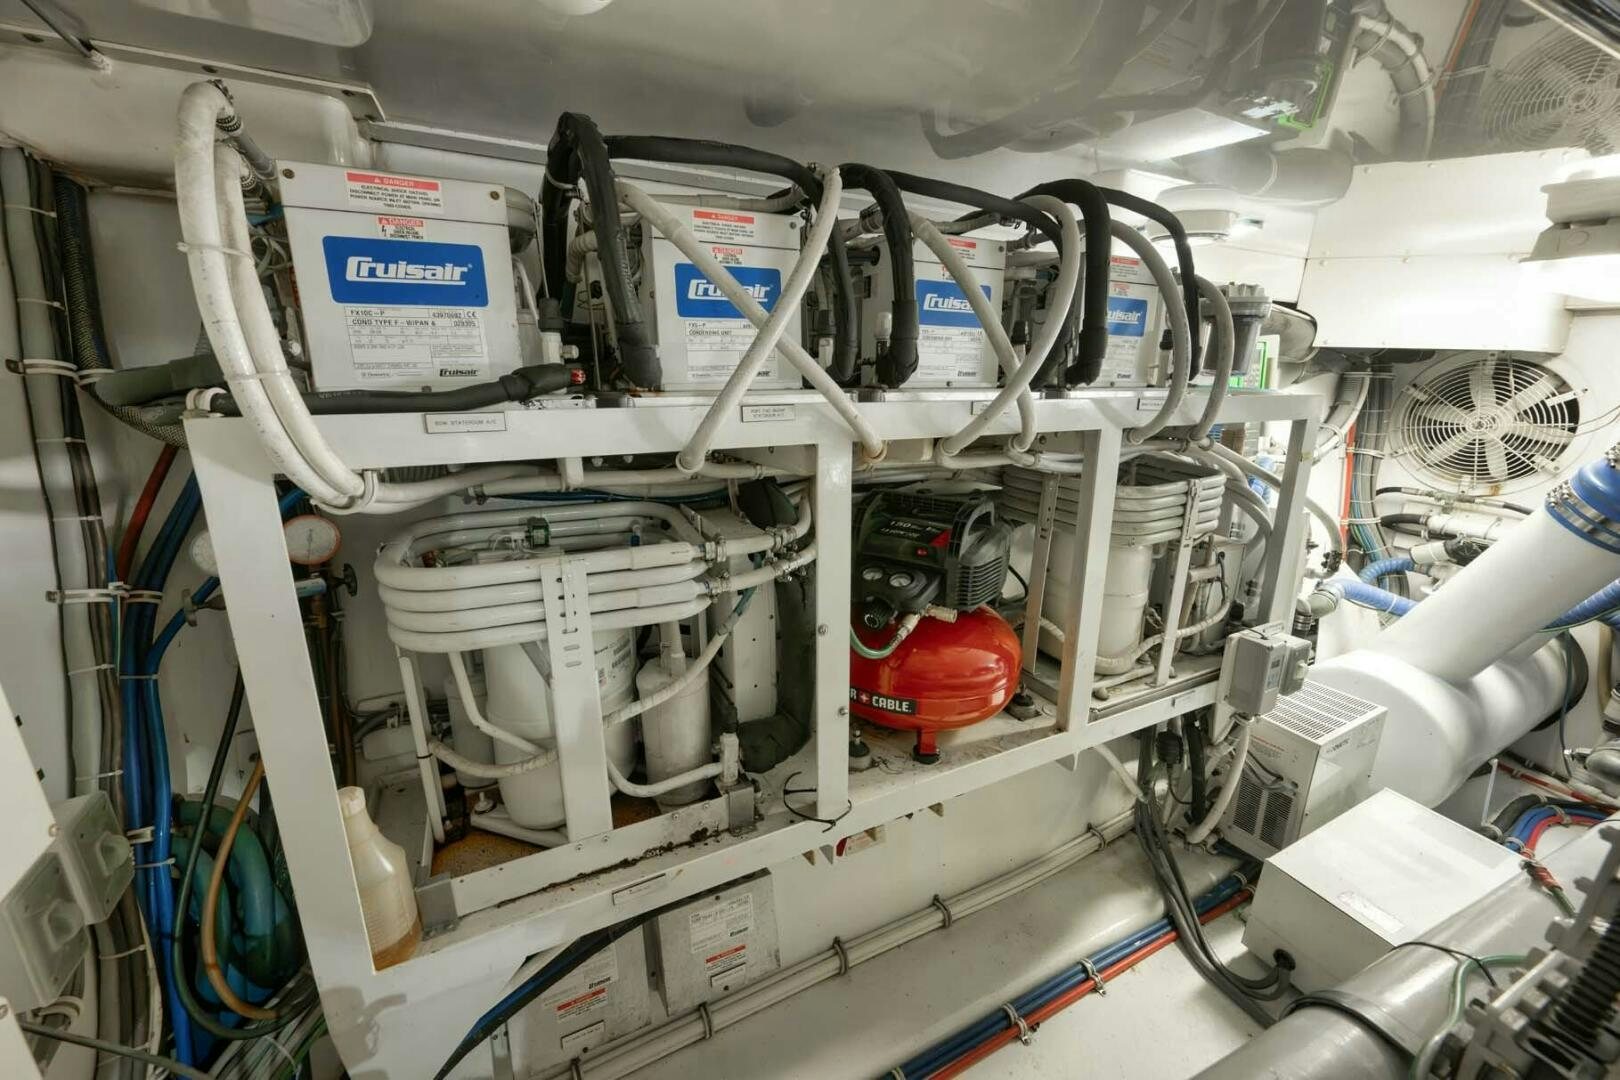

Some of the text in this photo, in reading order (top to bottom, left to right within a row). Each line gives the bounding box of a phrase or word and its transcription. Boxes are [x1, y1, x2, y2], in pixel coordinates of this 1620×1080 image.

[346, 256, 468, 286] Cruisair
[439, 368, 479, 377] Cruisair
[872, 696, 910, 712] CABLE
